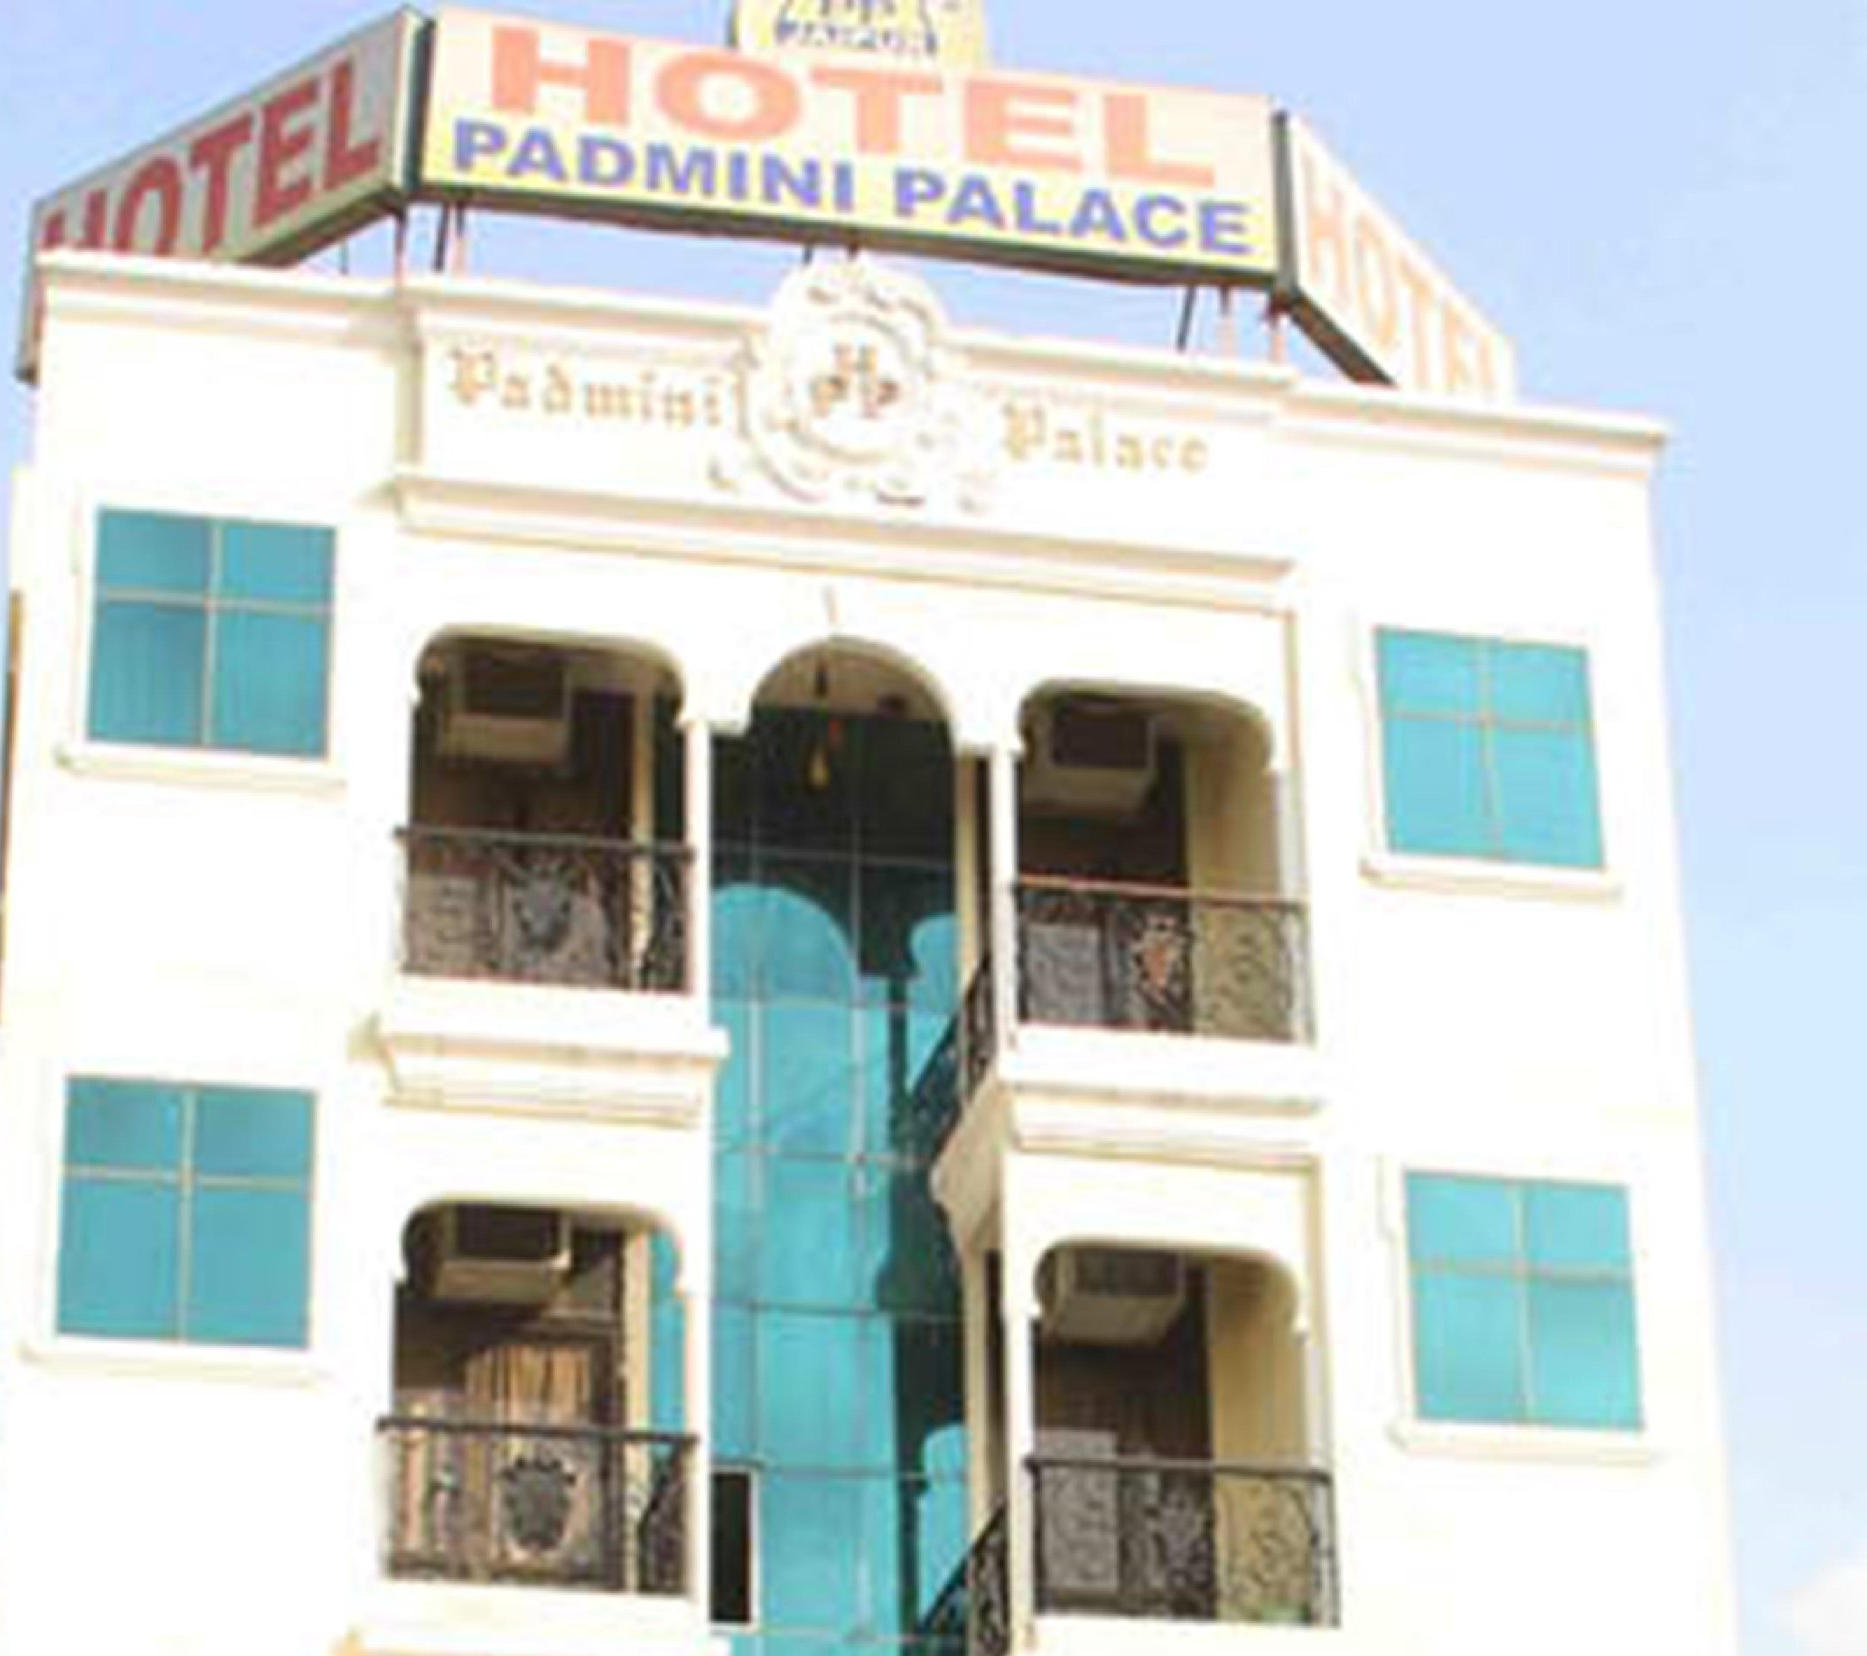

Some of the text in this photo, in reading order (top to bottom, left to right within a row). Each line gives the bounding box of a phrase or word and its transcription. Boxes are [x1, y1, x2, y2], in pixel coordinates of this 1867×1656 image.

[490, 26, 1215, 187] HOTEL
[453, 117, 1253, 255] PADMINI PALACE
[449, 345, 723, 426] Padmini
[1001, 403, 1211, 476] Palace
